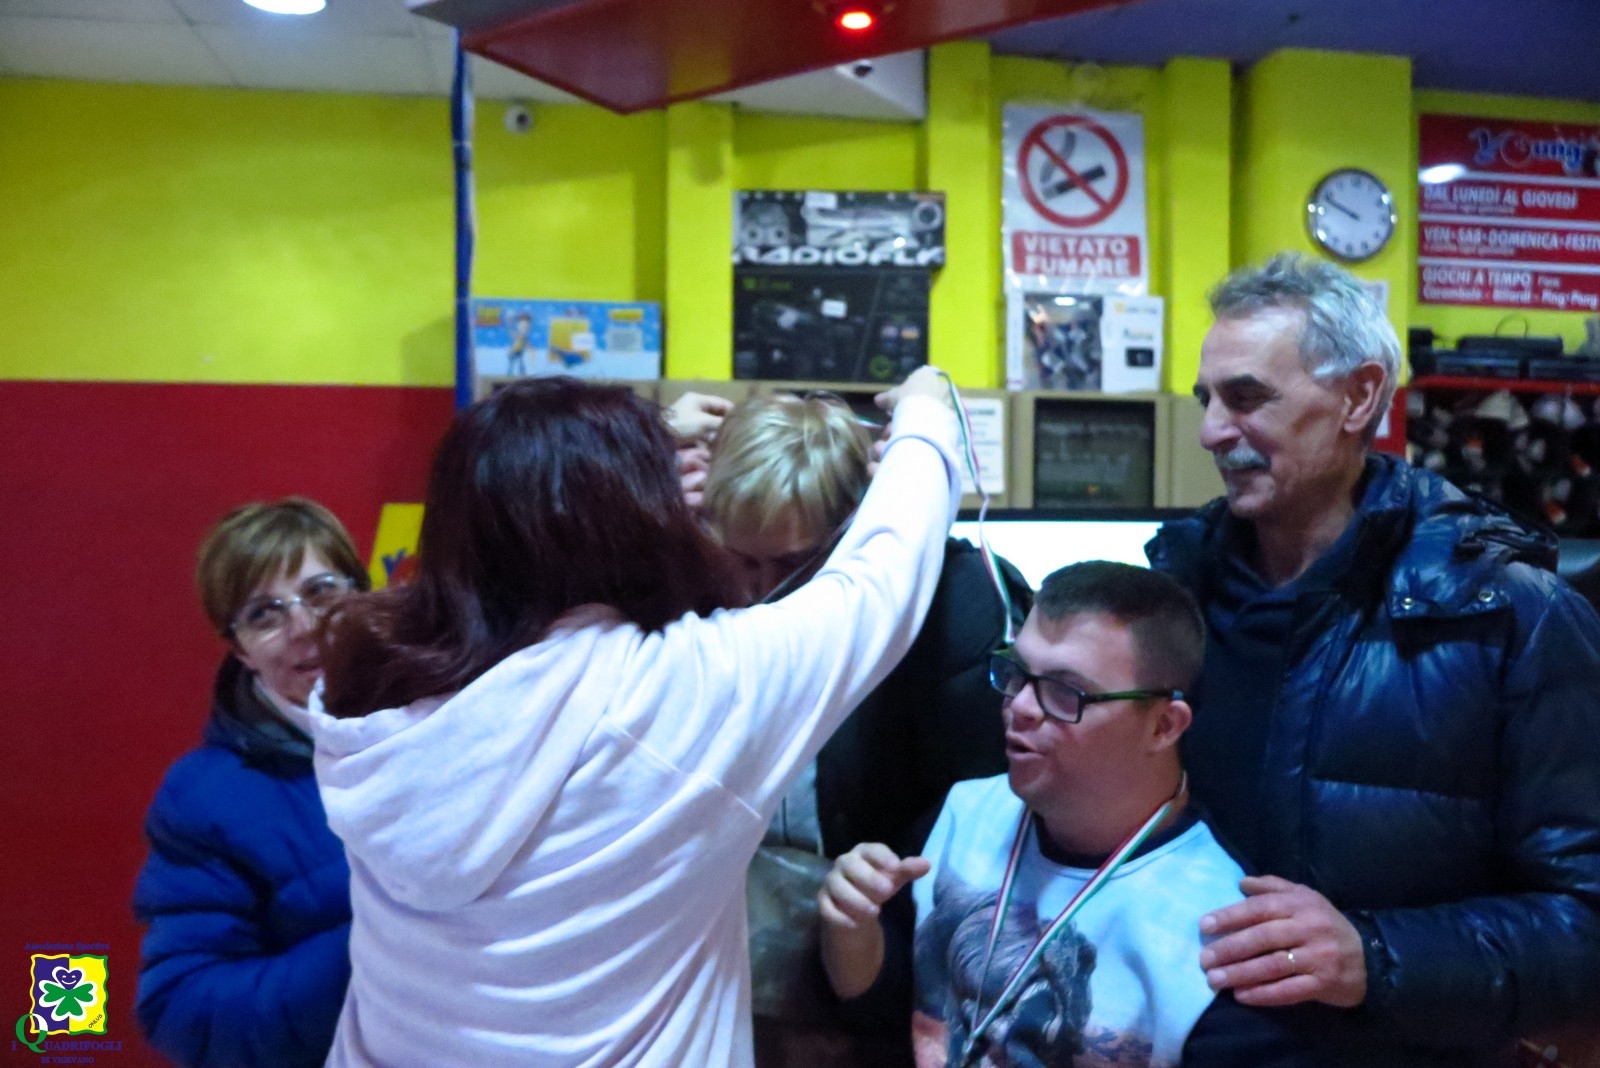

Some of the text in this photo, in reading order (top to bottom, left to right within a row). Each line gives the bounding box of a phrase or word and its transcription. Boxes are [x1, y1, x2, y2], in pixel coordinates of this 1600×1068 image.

[1023, 234, 1129, 256] VIETATO
[1025, 255, 1129, 275] FUMARE
[1422, 268, 1472, 285] GIOCHI
[1473, 270, 1484, 285] A
[1487, 271, 1532, 287] TEMPO
